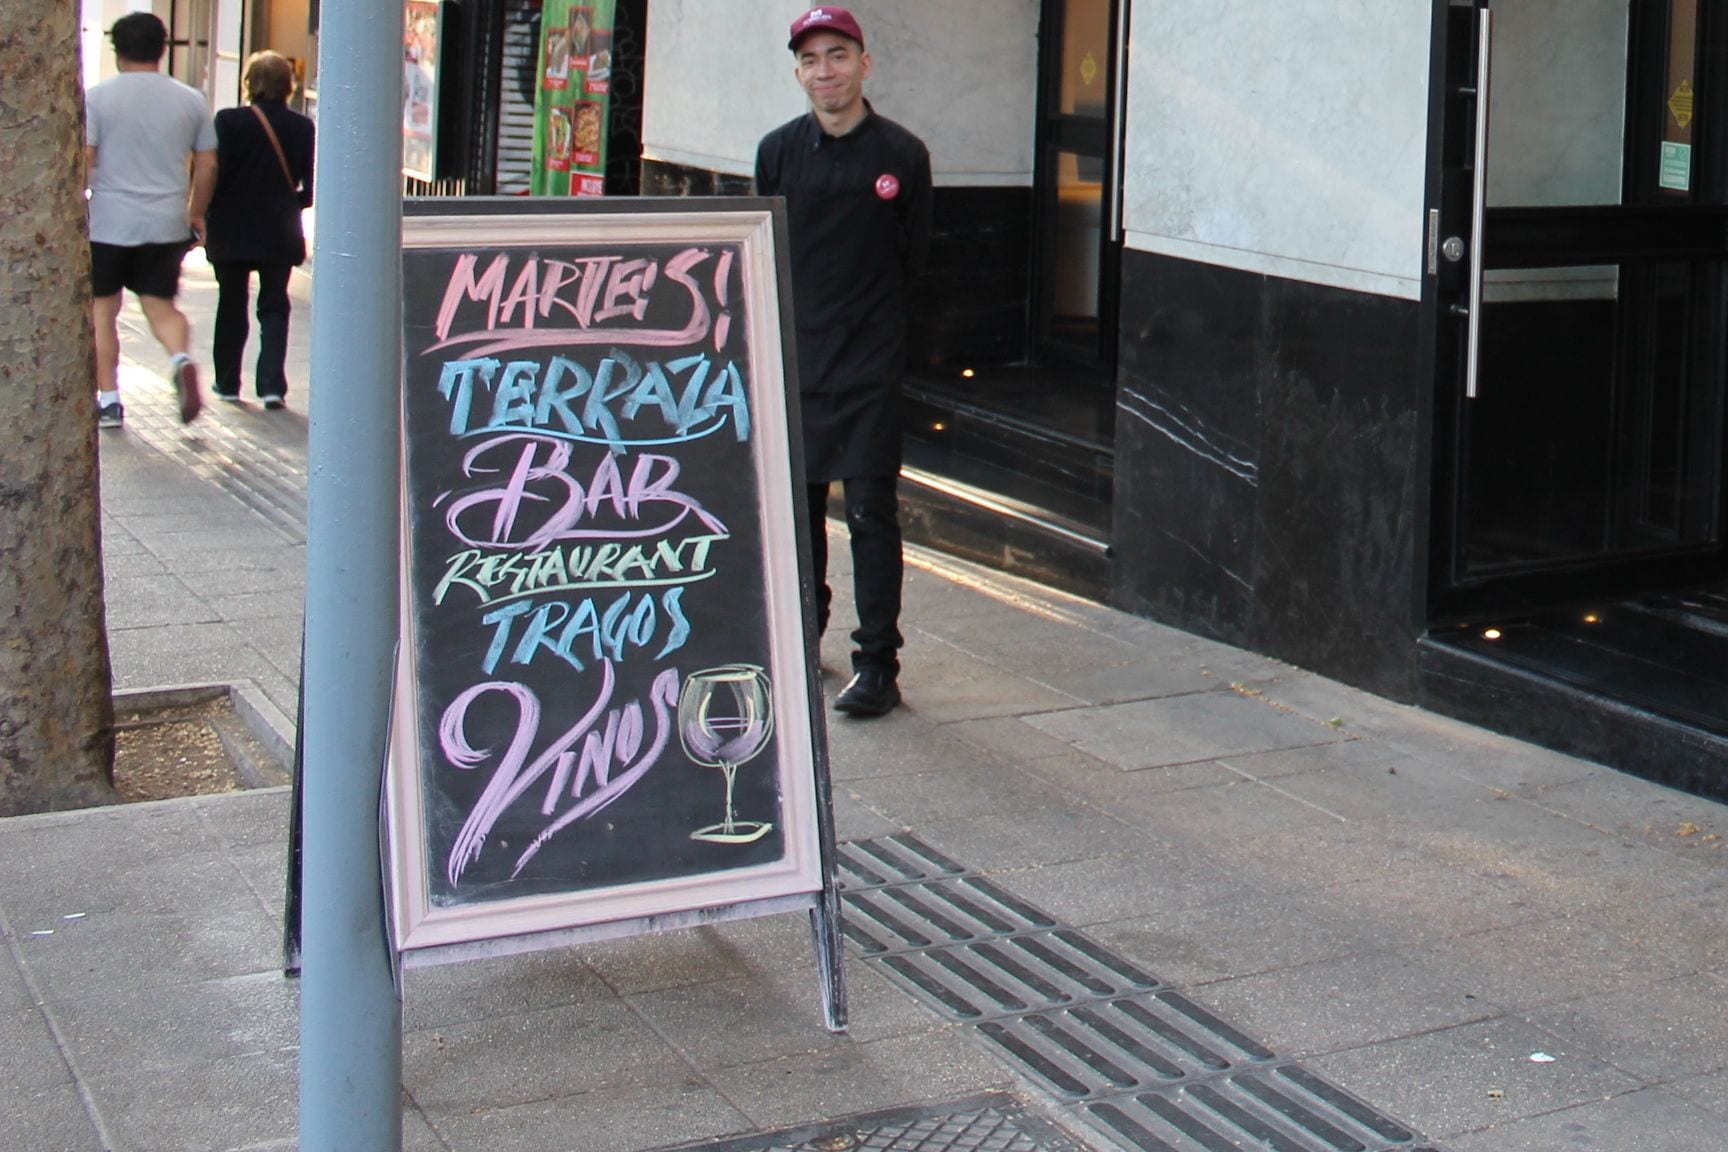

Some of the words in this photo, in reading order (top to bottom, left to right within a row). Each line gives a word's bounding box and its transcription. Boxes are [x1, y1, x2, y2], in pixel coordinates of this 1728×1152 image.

[437, 347, 749, 454] TERRAZA
[434, 533, 730, 607] RESTAURANT
[481, 587, 691, 675] TRAGOS
